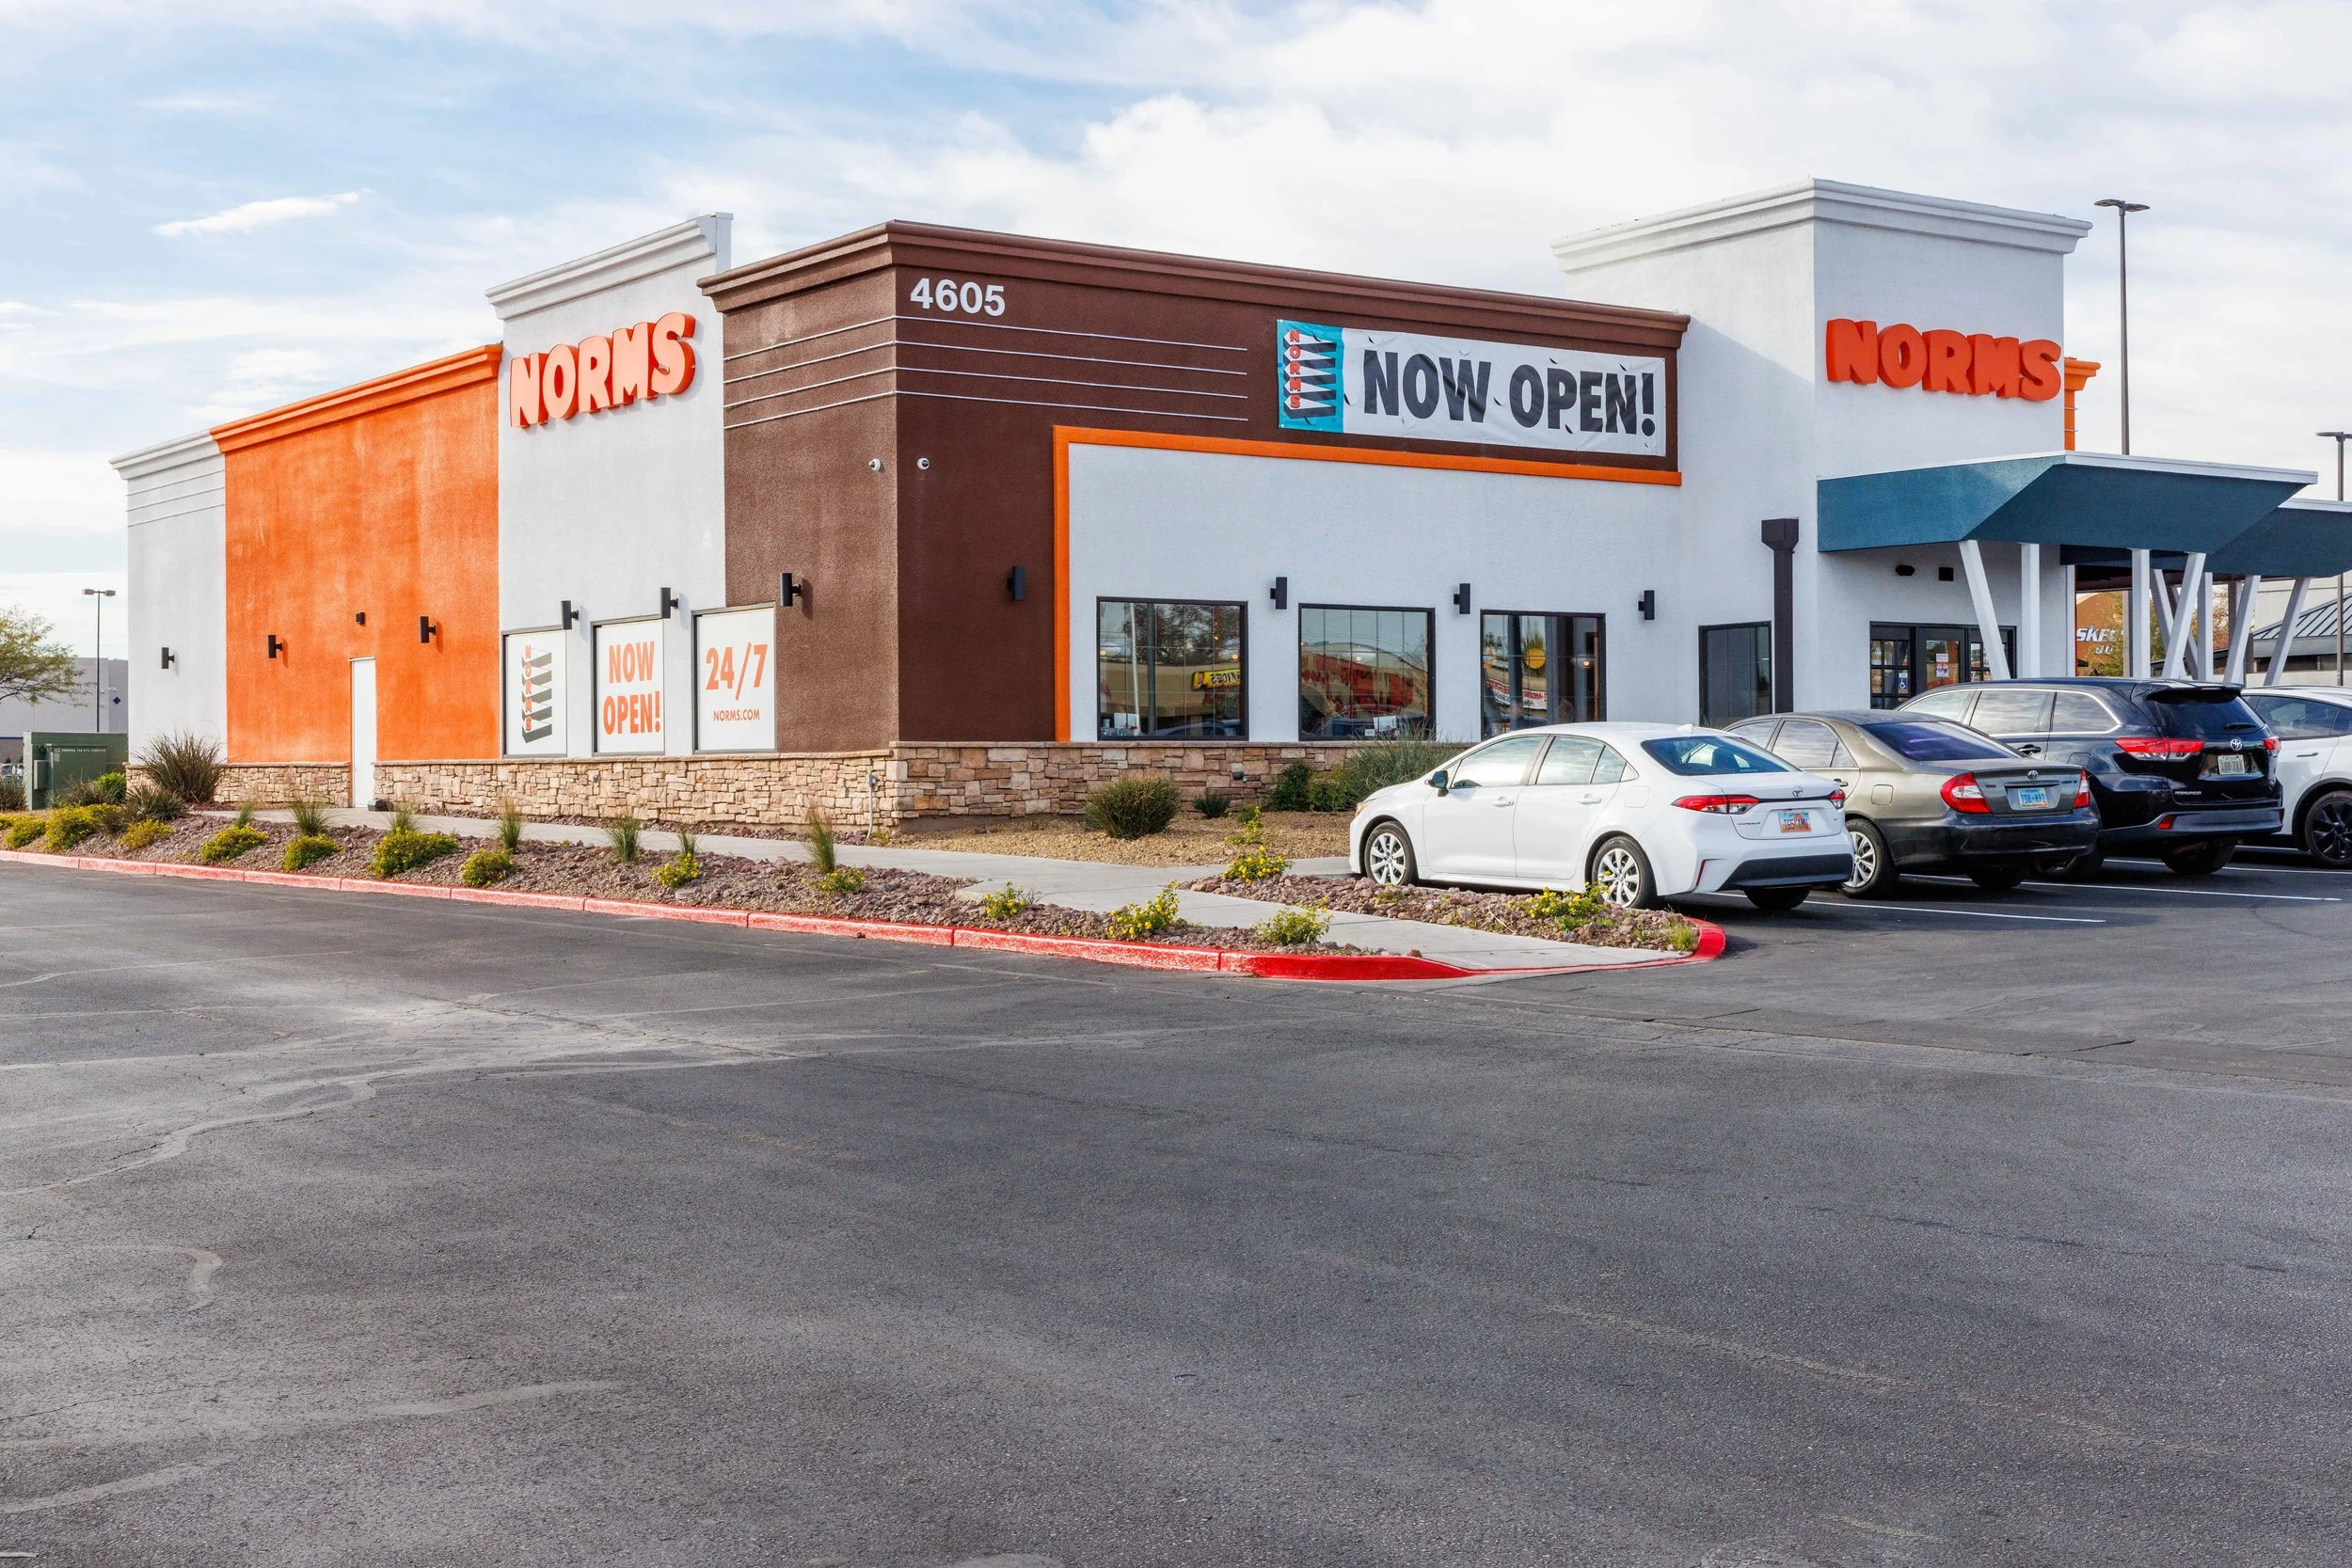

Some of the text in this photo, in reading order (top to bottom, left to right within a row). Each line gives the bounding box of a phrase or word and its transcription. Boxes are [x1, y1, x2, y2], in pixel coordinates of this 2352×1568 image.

[910, 277, 1006, 317] 4605
[509, 312, 696, 429] NORMS
[1289, 329, 1302, 409] NORMS
[1363, 349, 1656, 437] NOW OPEN!
[1826, 318, 2062, 402] NORMS
[523, 644, 532, 732] NORMS
[609, 641, 655, 684] NOW
[706, 641, 769, 701] 24/7
[603, 690, 660, 736] OPEN!
[713, 708, 760, 721] NORMS.COM
